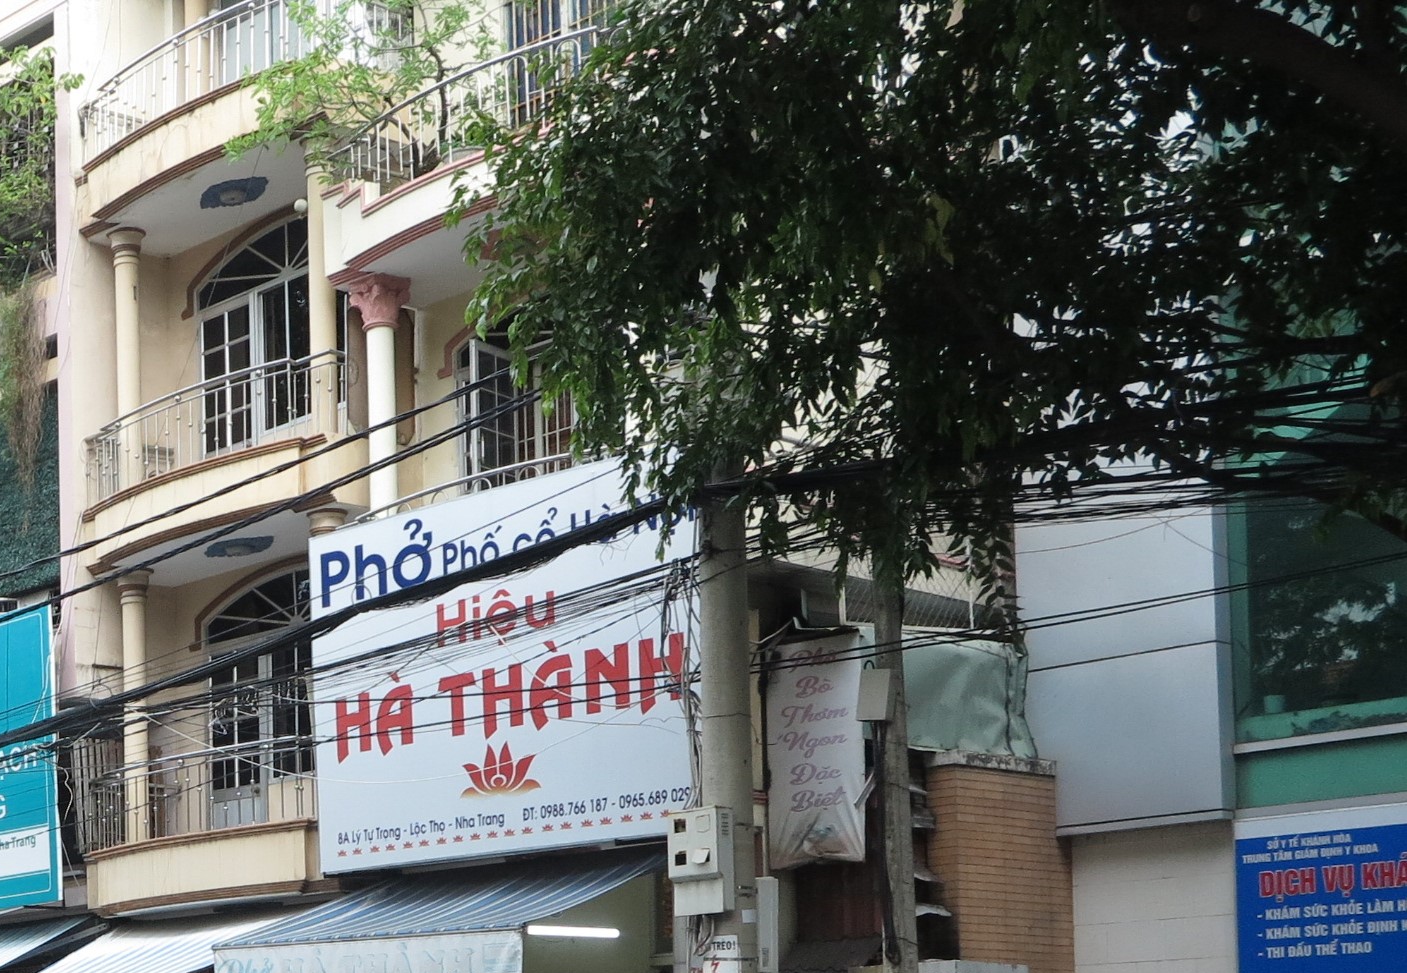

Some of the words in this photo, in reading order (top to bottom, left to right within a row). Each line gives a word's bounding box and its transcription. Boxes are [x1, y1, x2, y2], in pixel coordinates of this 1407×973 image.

[320, 518, 433, 608] Phở
[437, 589, 555, 647] Hiệu
[336, 672, 414, 764] HÀ
[438, 632, 686, 740] THÀNH
[795, 676, 834, 699] Bò
[782, 704, 849, 728] Thơm
[780, 731, 848, 758] Ngon
[523, 806, 538, 822] ĐT:
[540, 801, 586, 819] 0988.766
[591, 797, 607, 813] 187
[619, 790, 668, 809] 0965.689
[11, 835, 36, 848] Trang
[338, 832, 350, 846] 8A
[352, 829, 362, 845] Lý
[363, 829, 375, 844] Tự
[376, 826, 401, 841] Trọng
[409, 822, 427, 837] Lộc
[429, 819, 445, 836] Thọ
[455, 816, 475, 830] Nha
[477, 813, 505, 828] Trang
[1281, 839, 1287, 848] Y
[1300, 834, 1331, 847] KHÁNH
[1242, 852, 1271, 864] TRUNG
[1345, 846, 1351, 855] Y
[1353, 843, 1378, 855] KHOA
[1259, 866, 1315, 903] DỊCH
[1322, 864, 1354, 898] VỤ
[1265, 905, 1300, 921] KHÁM
[1303, 903, 1328, 918] SỨC
[1331, 899, 1364, 916] KHỎE
[1367, 898, 1394, 914] LÀM
[1265, 924, 1301, 940] KHÁM
[1304, 922, 1328, 938] SỨC
[1332, 919, 1364, 935] KHỎE
[1367, 920, 1398, 936] ĐỊNH
[1266, 946, 1285, 959] THI
[1287, 941, 1312, 957] ĐẤU
[1341, 941, 1372, 954] THAO
